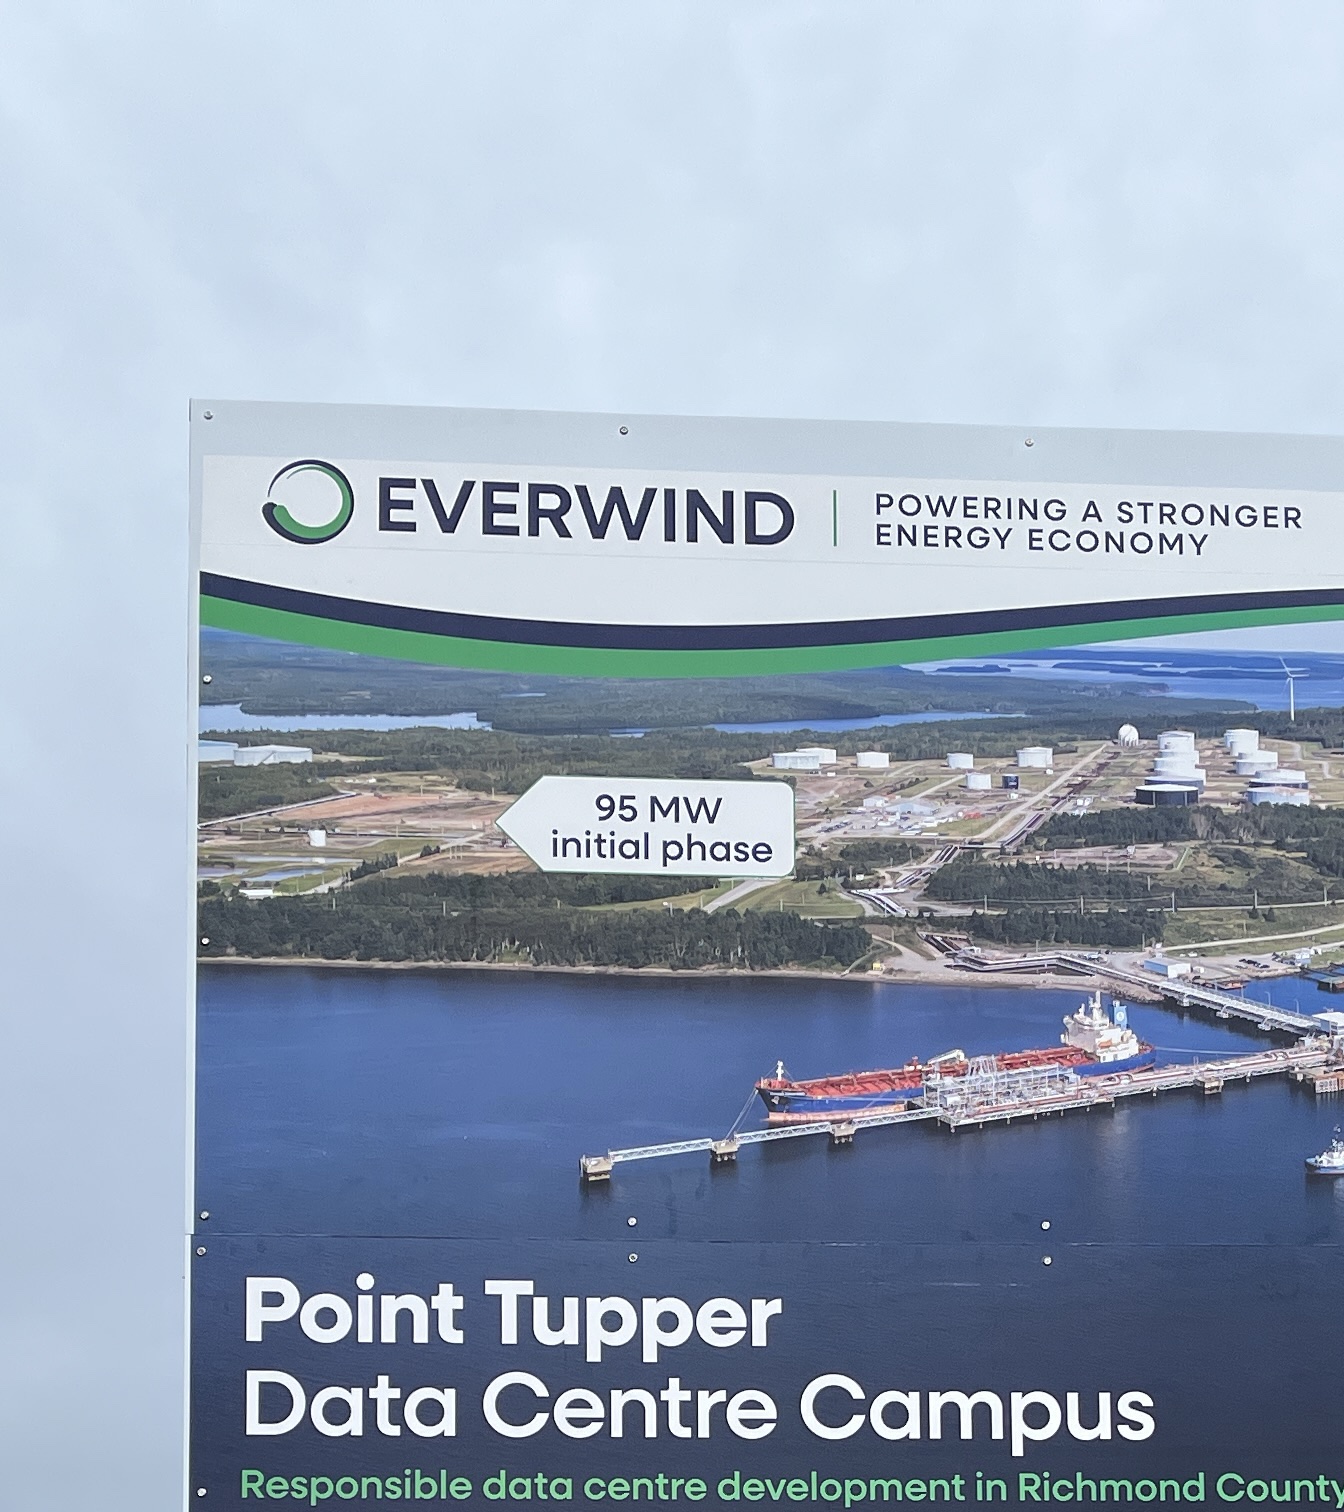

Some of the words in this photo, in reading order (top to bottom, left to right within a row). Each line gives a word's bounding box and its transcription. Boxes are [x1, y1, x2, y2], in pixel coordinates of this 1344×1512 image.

[378, 476, 795, 546] EVERWIND
[875, 493, 1067, 522] POWERING
[1081, 500, 1103, 523] A
[1117, 501, 1302, 530] STRONGER
[876, 523, 1013, 550] ENERGY
[1028, 528, 1209, 556] ECONOMY
[595, 793, 638, 823] 95
[649, 795, 723, 825] MW
[551, 829, 649, 860] initial
[662, 833, 773, 868] phase
[245, 1272, 464, 1344] Point
[484, 1279, 782, 1363] Tupper
[245, 1370, 457, 1438] Data
[482, 1371, 778, 1440] Centre
[800, 1373, 1155, 1457] Campus
[241, 1468, 473, 1507] Responsible
[482, 1469, 573, 1500] data
[583, 1473, 707, 1501] centre
[717, 1470, 966, 1508] development
[975, 1471, 1007, 1501] in
[1018, 1471, 1205, 1502] Richmond
